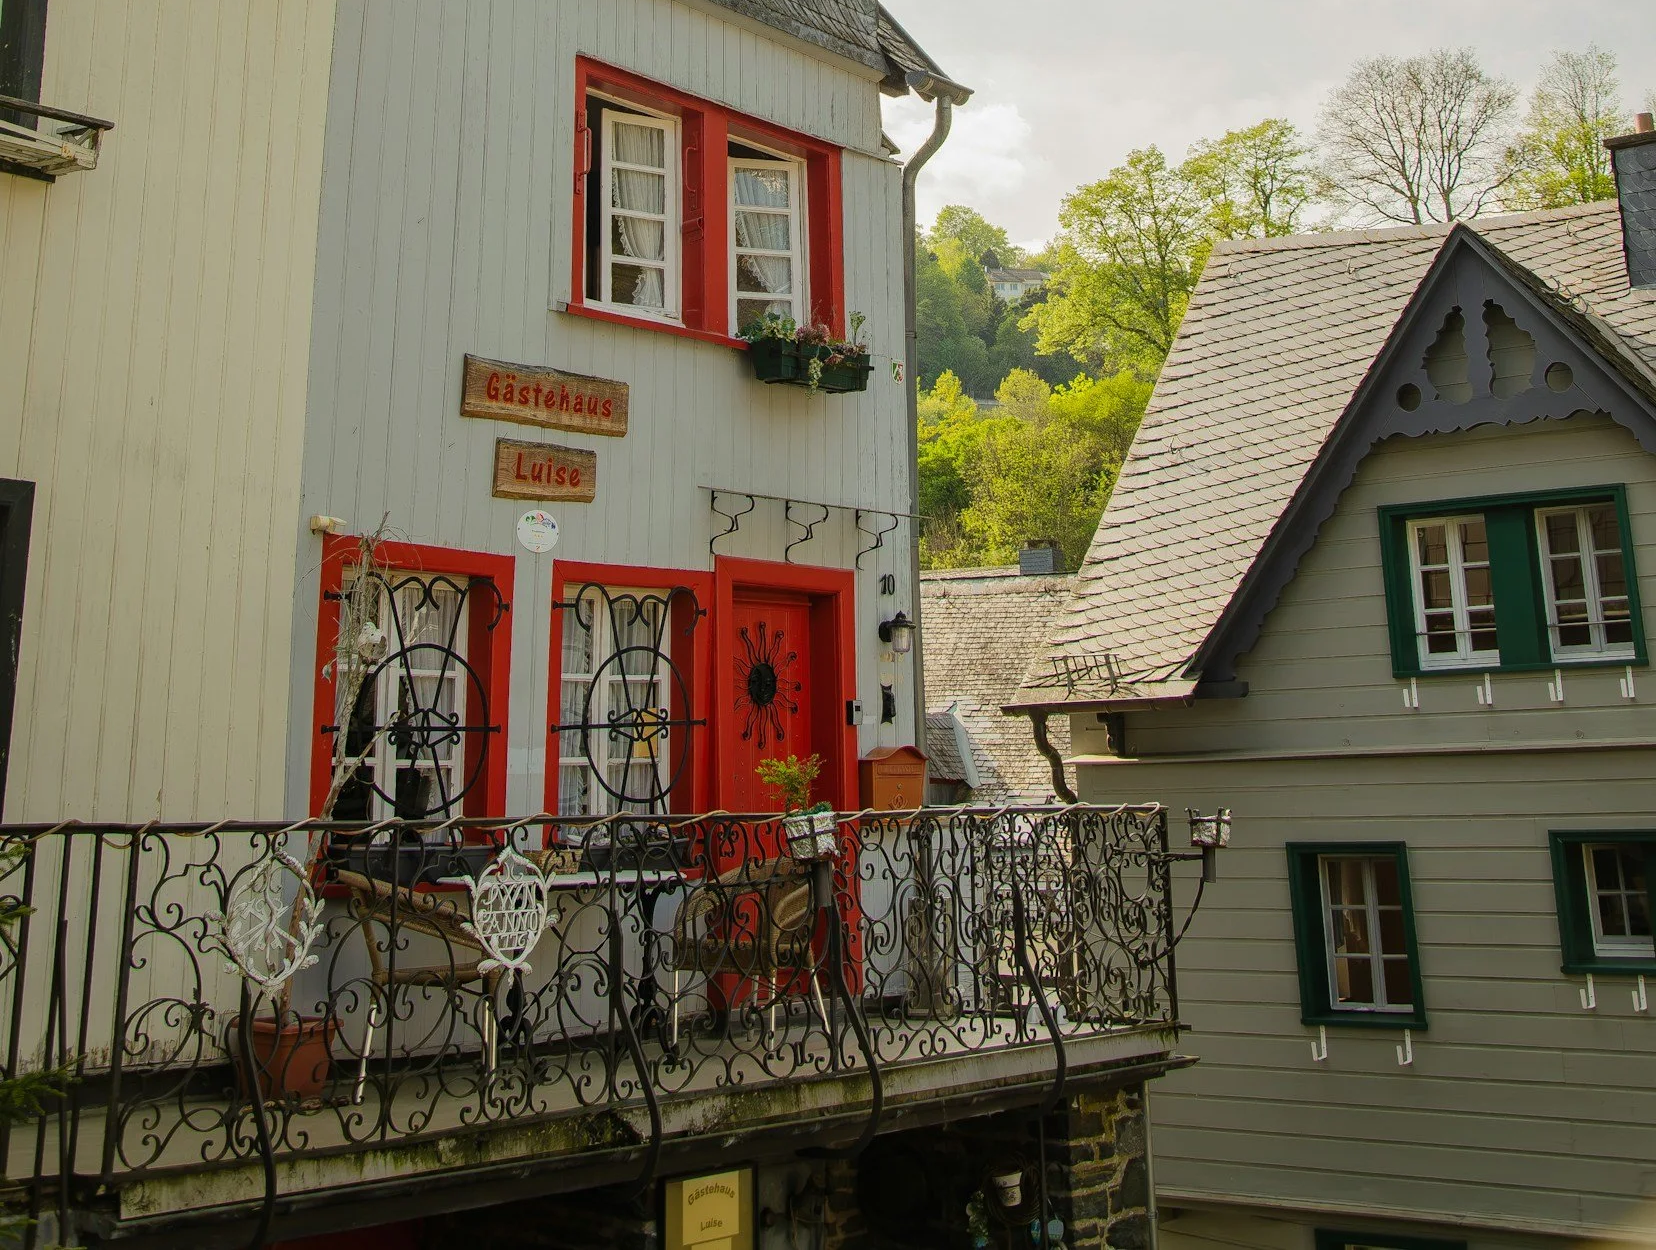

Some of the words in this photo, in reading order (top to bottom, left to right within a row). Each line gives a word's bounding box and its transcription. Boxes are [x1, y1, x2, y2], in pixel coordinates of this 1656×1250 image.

[486, 372, 612, 417] Gästehaus
[515, 452, 581, 487] Luise
[879, 573, 895, 596] 10
[688, 1182, 736, 1206] Gästehaus
[700, 1217, 723, 1232] Luise
